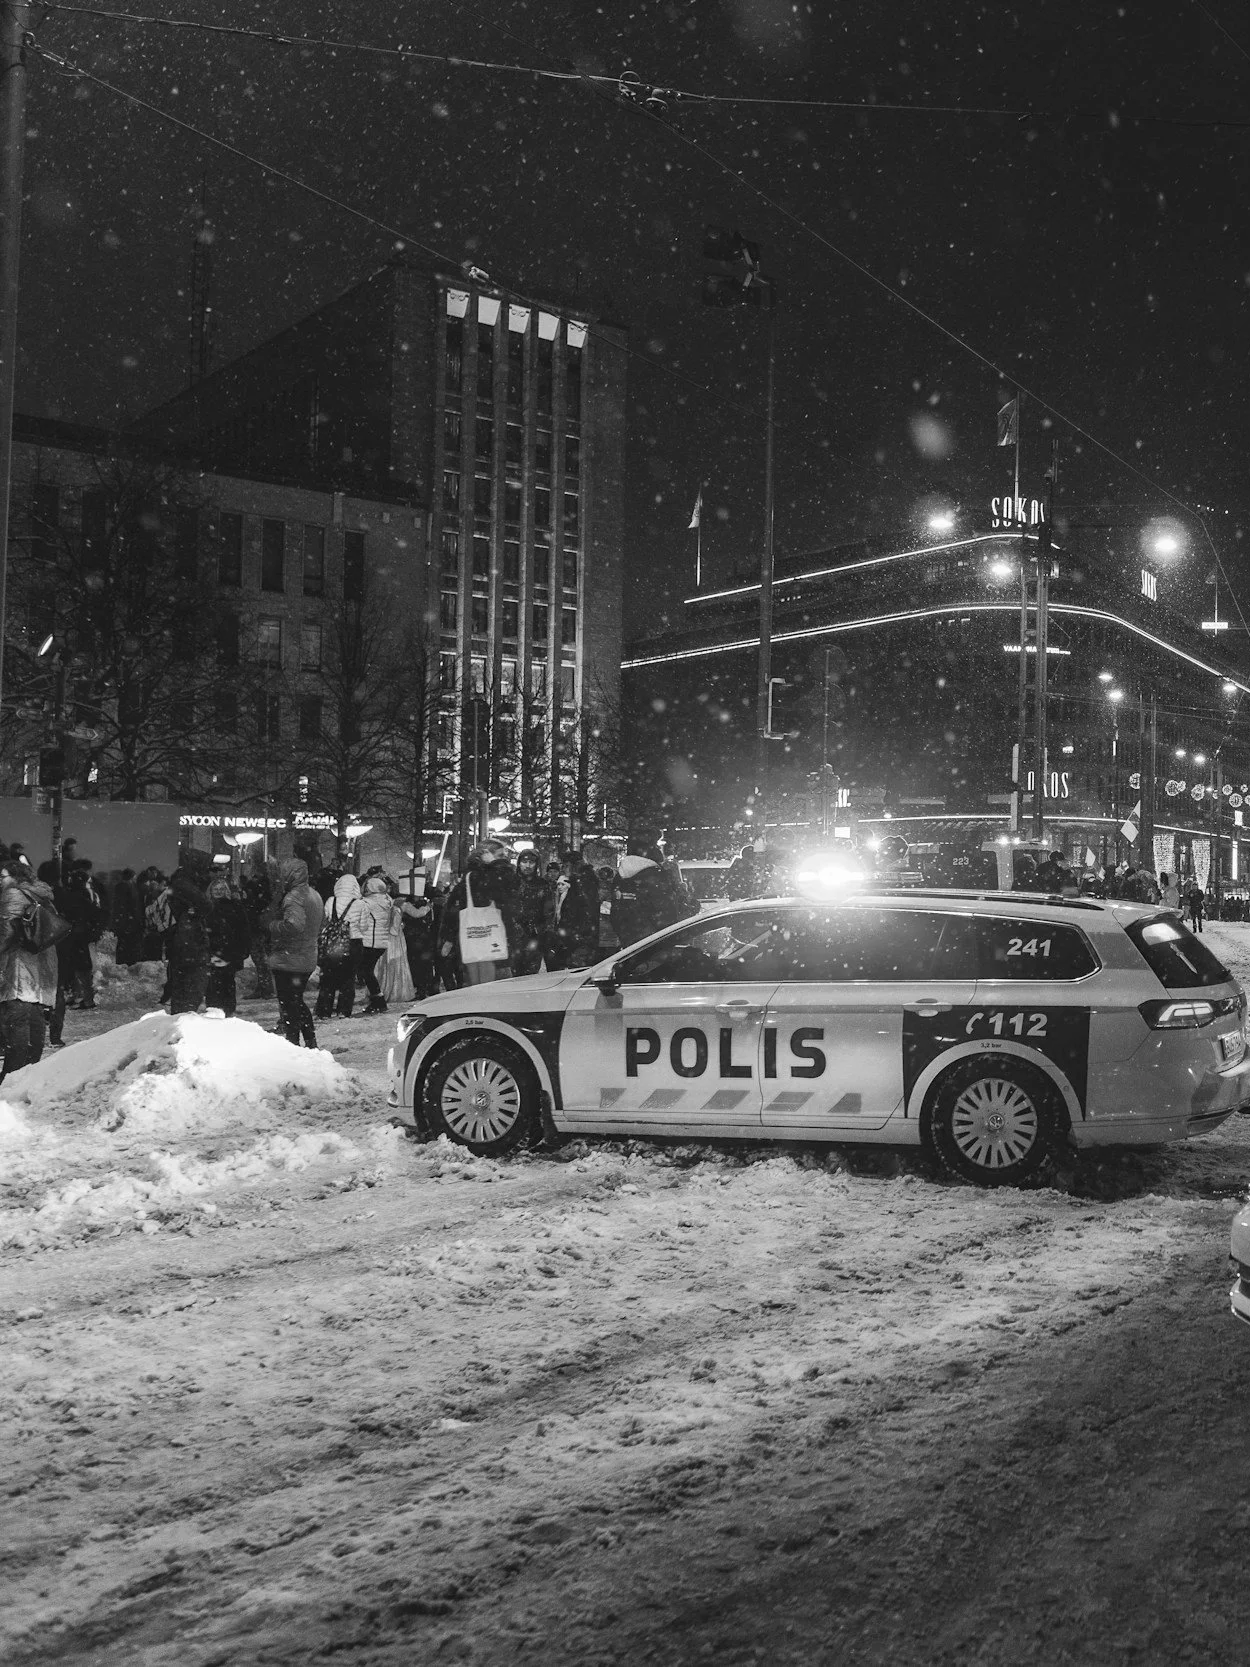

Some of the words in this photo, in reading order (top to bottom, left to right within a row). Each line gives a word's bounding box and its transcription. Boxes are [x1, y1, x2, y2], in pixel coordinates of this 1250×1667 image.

[224, 817, 287, 829] NEWSEC
[953, 857, 969, 866] 223
[1006, 938, 1051, 957] 241
[988, 1012, 1048, 1037] 112
[626, 1026, 827, 1079] POLIS
